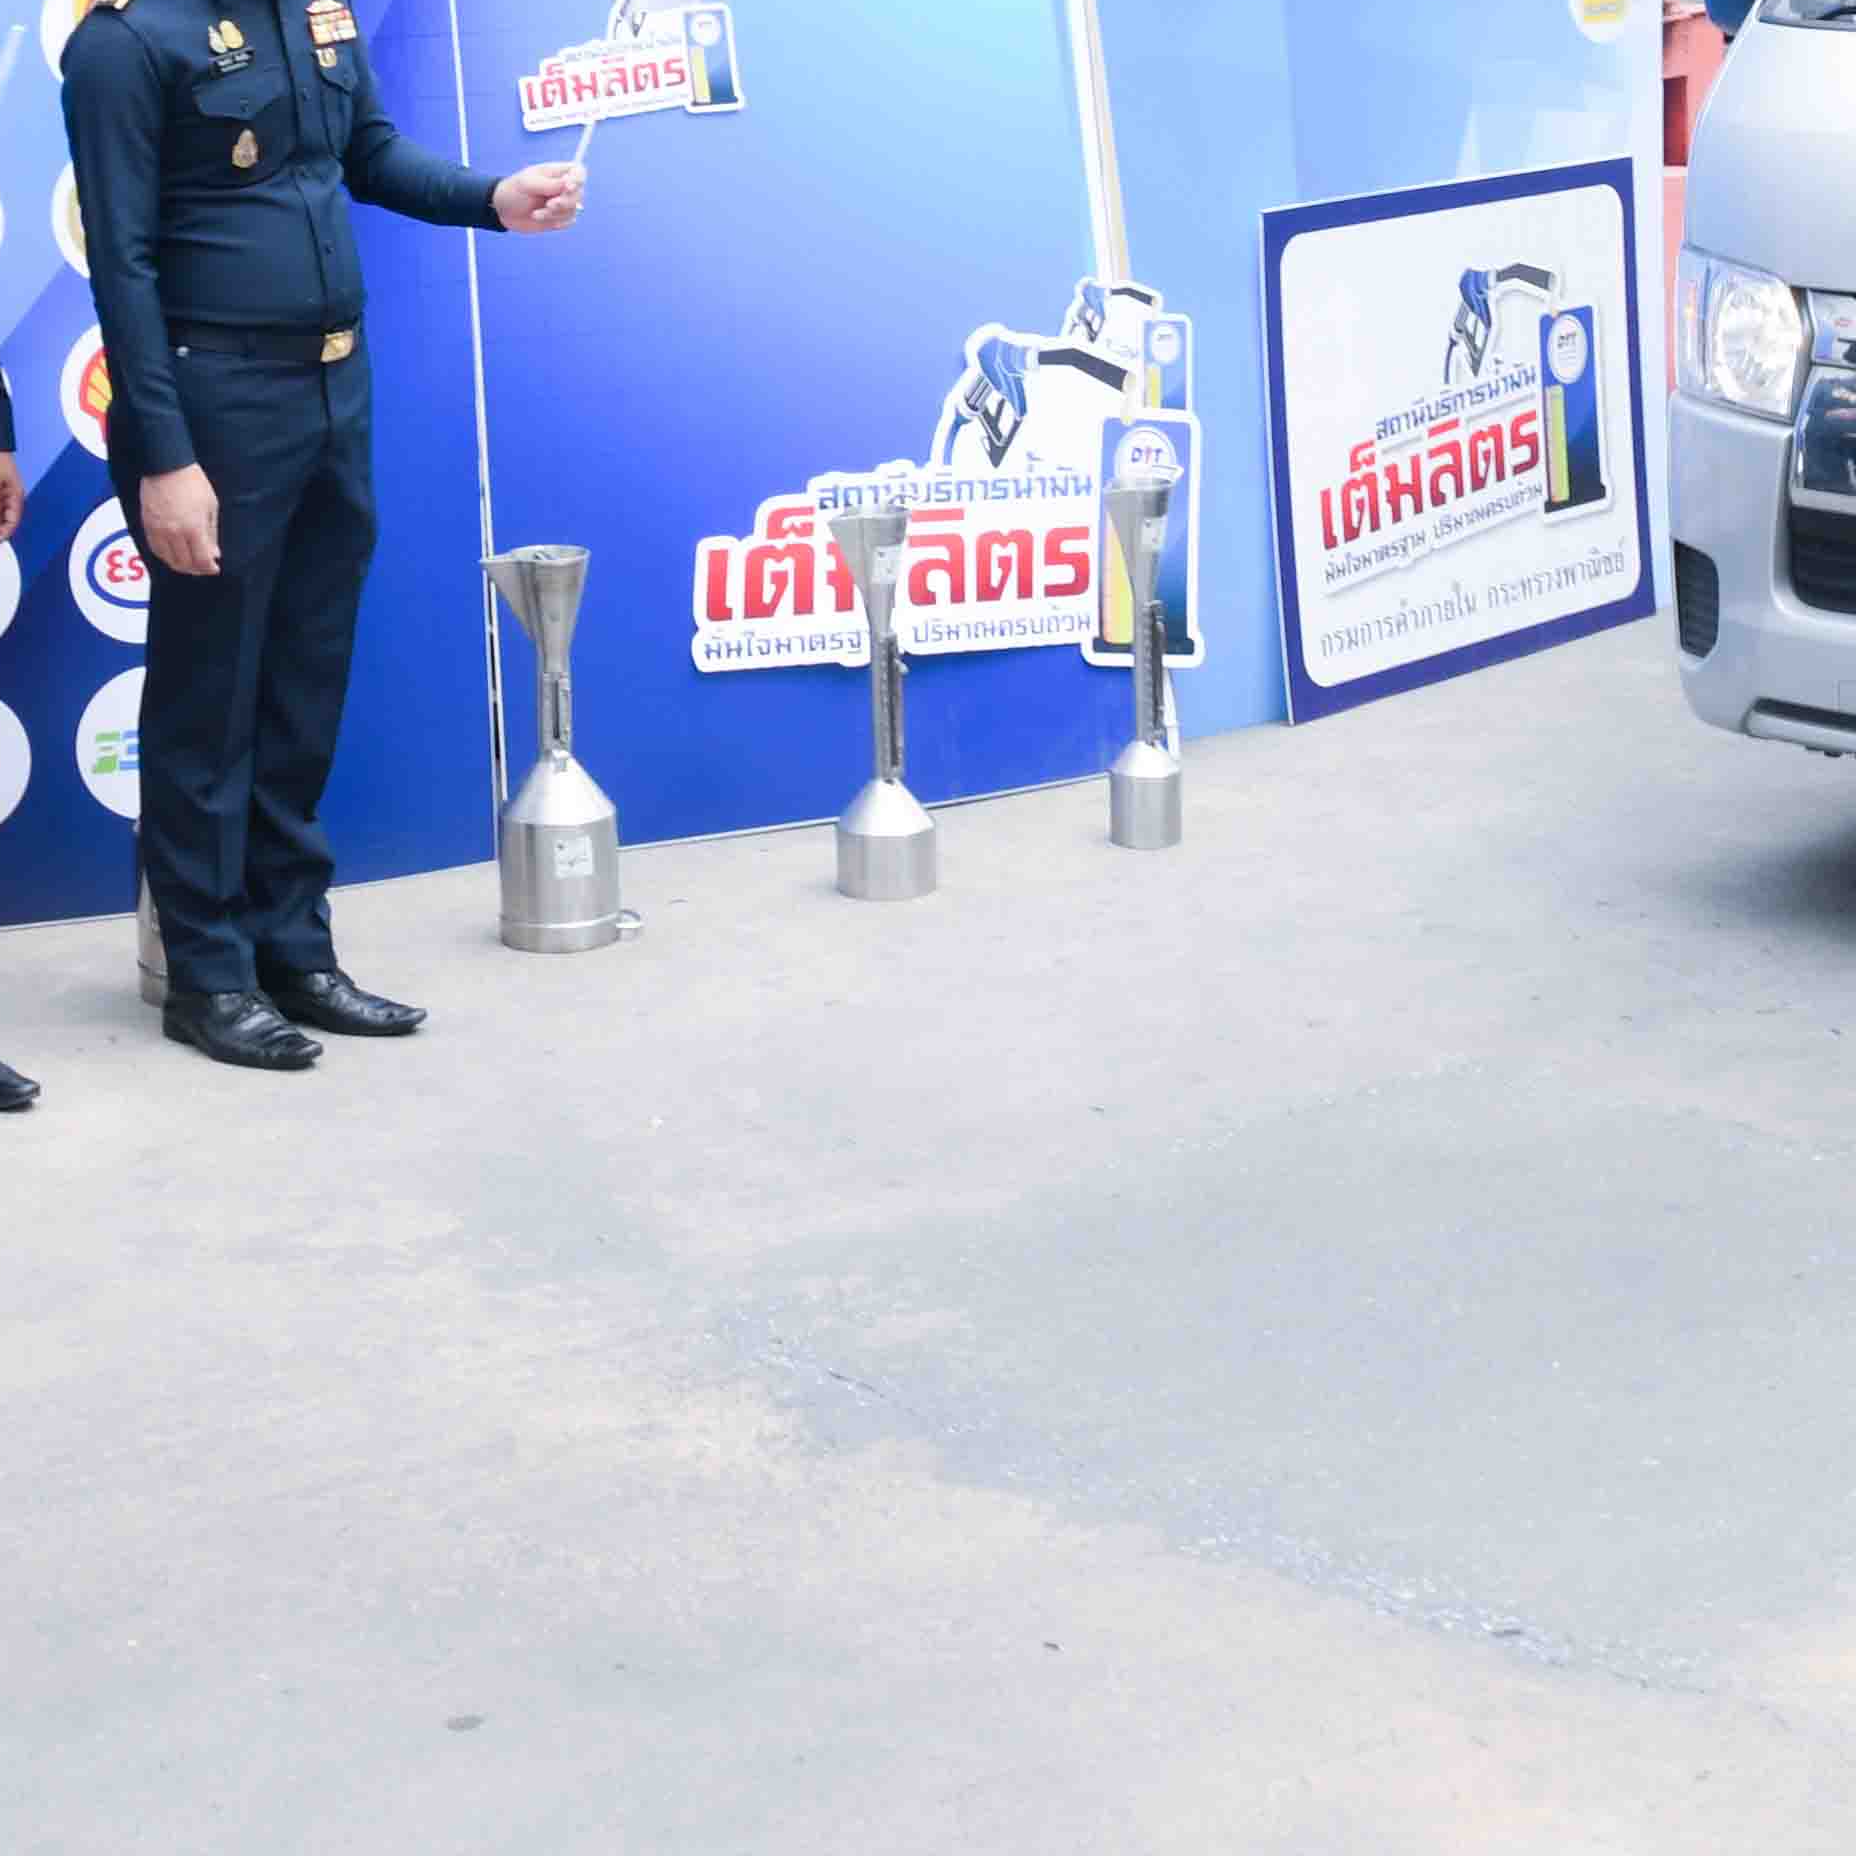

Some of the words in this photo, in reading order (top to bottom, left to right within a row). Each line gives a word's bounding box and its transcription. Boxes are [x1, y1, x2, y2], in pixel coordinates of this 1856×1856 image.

[525, 55, 688, 112] เต็มลิตร
[1375, 358, 1537, 442] สถานีบริการน้ำมัน
[1320, 411, 1541, 551] เต็มลิตร
[106, 549, 145, 585] Es
[1324, 530, 1427, 585] มั่นใจมาตรฐาน
[1320, 584, 1478, 659] กรมการค้าภายใน
[1487, 535, 1626, 606] กระทรวงพาณิชย์
[704, 620, 874, 661] มั่นใจมาตรฐ
[911, 604, 1092, 645] ปริมาณครบถ้วน
